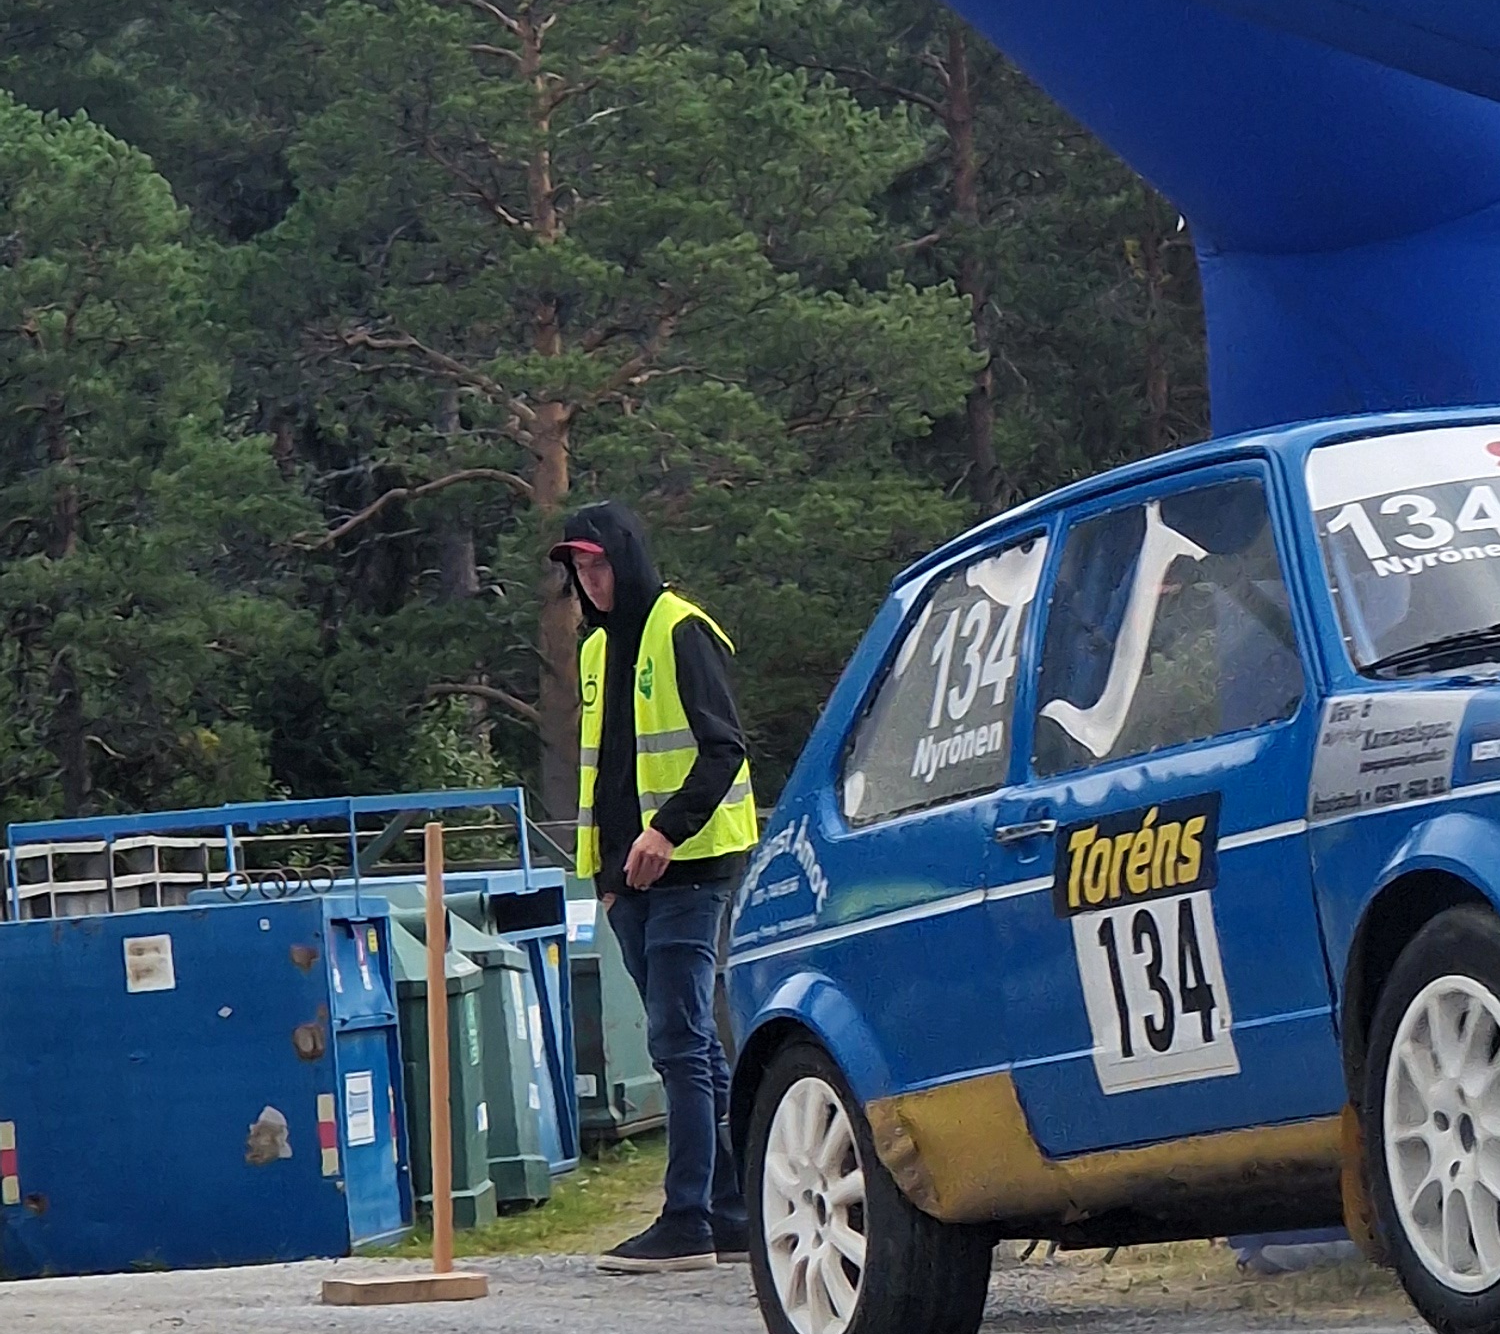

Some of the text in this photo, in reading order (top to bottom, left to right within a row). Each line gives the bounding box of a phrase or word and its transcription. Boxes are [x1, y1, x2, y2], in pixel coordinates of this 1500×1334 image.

[930, 599, 1023, 729] 134
[910, 720, 1004, 783] Nyrönen
[1067, 806, 1207, 908] Toréns
[1097, 897, 1216, 1058] 134
